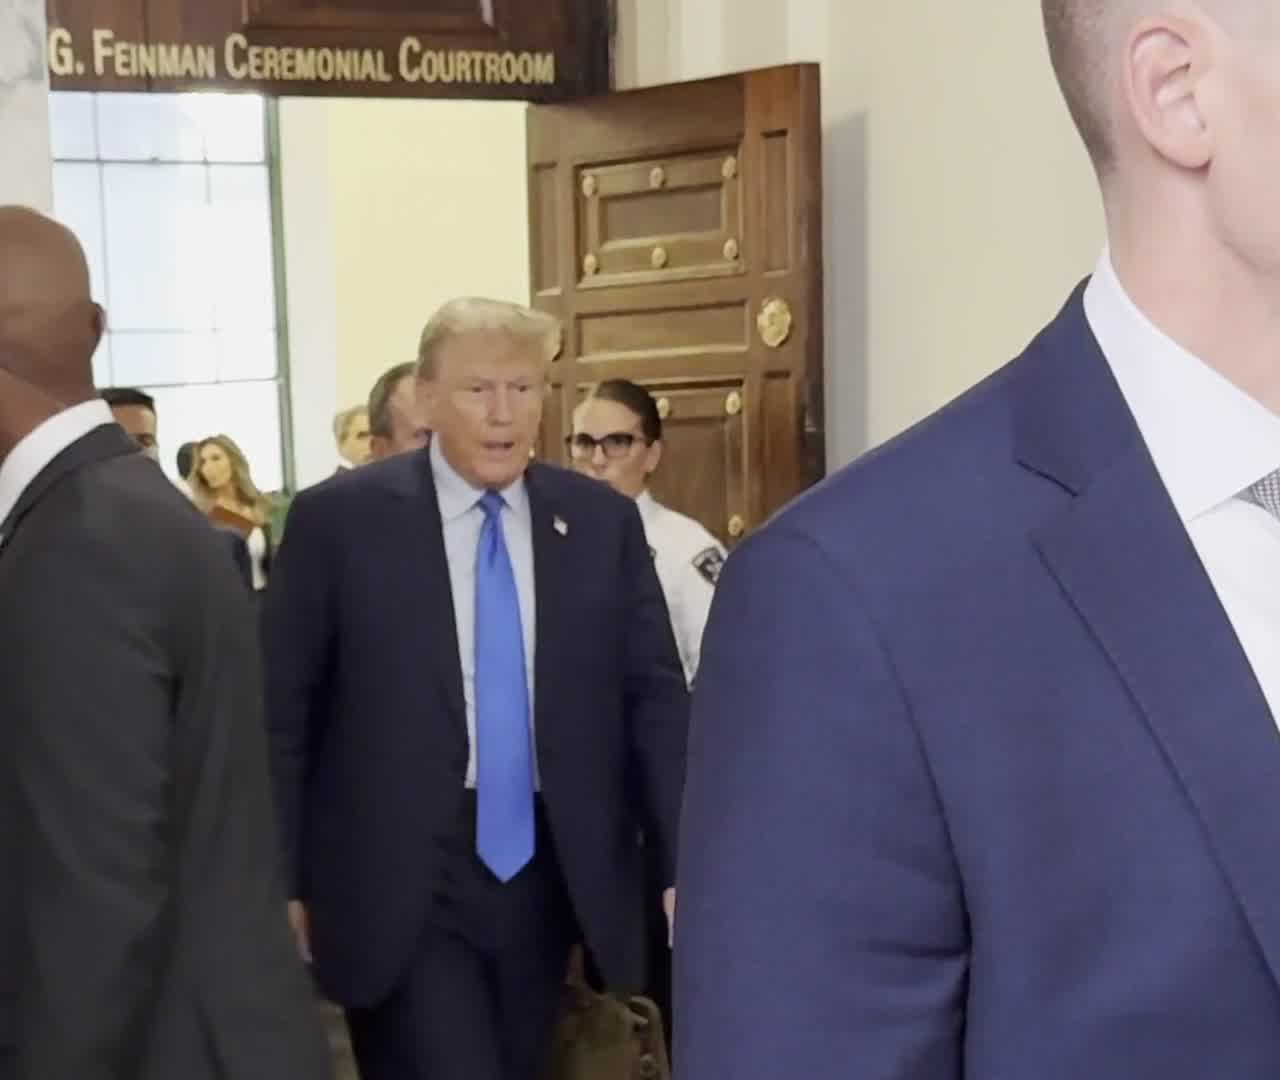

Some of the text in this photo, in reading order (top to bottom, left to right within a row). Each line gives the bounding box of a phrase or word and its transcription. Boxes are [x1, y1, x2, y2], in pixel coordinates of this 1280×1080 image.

[49, 28, 555, 85] G. FEINMAN CEREMONIAL COURTROOM
